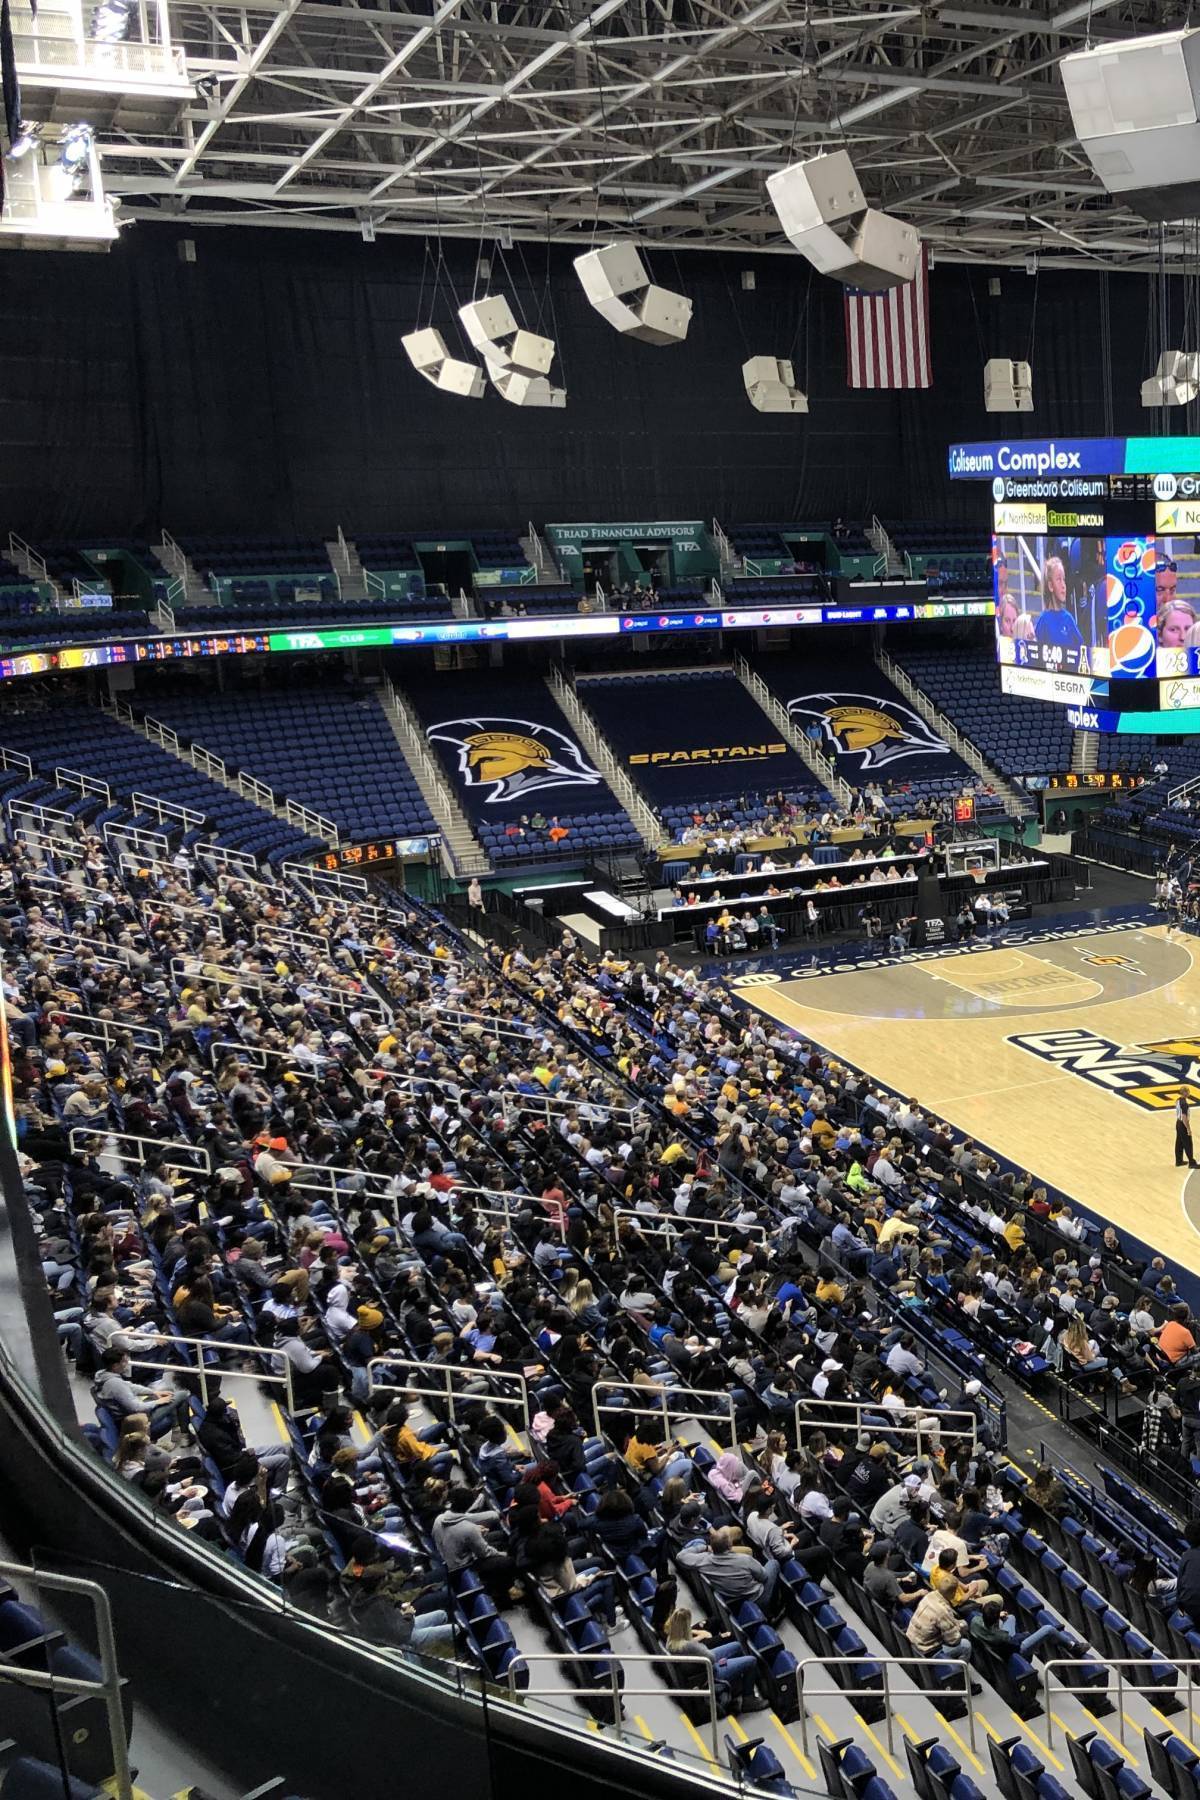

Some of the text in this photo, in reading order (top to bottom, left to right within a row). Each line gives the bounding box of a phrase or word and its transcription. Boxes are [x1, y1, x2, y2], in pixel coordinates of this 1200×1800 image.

[952, 443, 1081, 475] Coliseum Complex
[1006, 479, 1104, 497] Greensboro Coliseum
[1009, 512, 1046, 525] NorthState
[1049, 511, 1104, 527] GREEN LINCOLN
[556, 526, 694, 539] TRIAD FINANCIAL ADVISORS
[676, 542, 702, 551] TFA
[1122, 545, 1142, 618] pepsi
[949, 605, 965, 615] THE
[216, 641, 228, 650] 20
[339, 634, 365, 643] CLUB
[83, 652, 98, 666] 24
[1042, 645, 1062, 663] 5:40
[1165, 652, 1188, 672] 23
[1054, 680, 1085, 695] SEGRA
[629, 743, 787, 764] SPARTANS
[957, 808, 970, 819] 30
[925, 919, 944, 928] TFA
[791, 921, 1147, 979] Greensboro Coliseum
